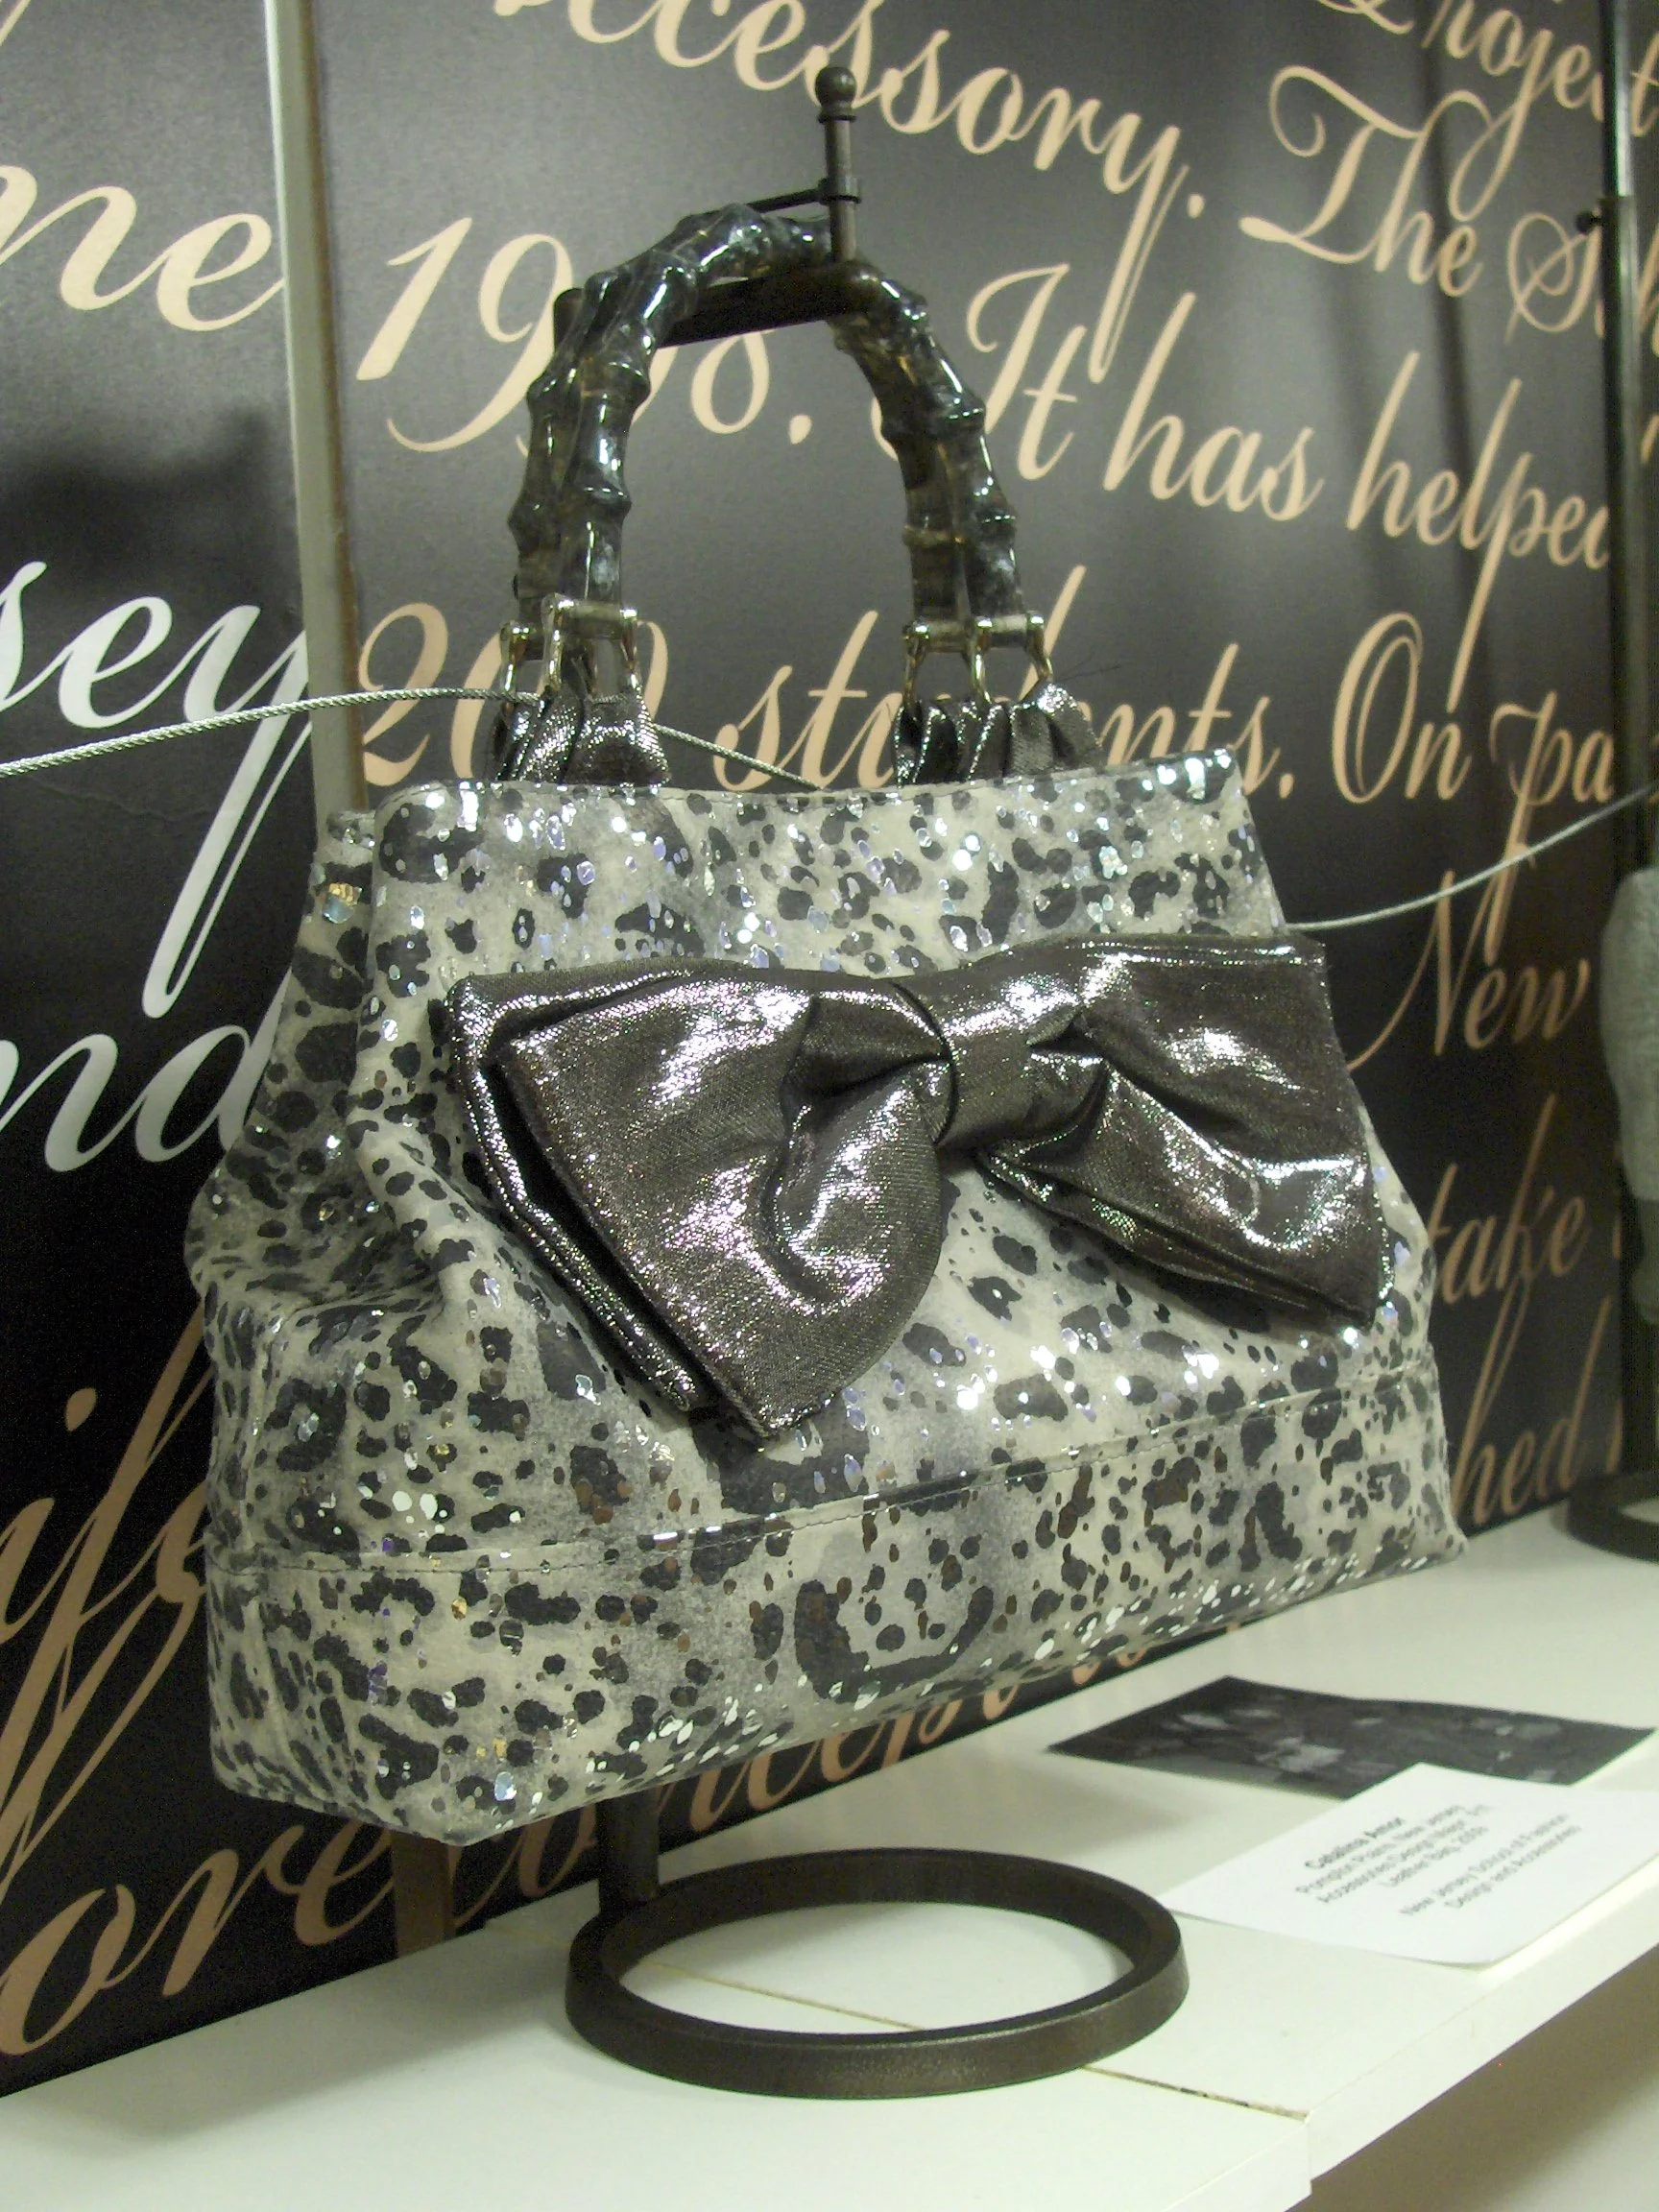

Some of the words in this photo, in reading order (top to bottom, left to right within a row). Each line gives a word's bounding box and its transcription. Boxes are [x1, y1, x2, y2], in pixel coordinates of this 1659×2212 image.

[1240, 64, 1484, 298] The
[357, 217, 814, 455] 198.
[871, 264, 1076, 480] It
[1103, 292, 1324, 521] has
[1333, 613, 1473, 805] On
[1346, 844, 1591, 1072] New
